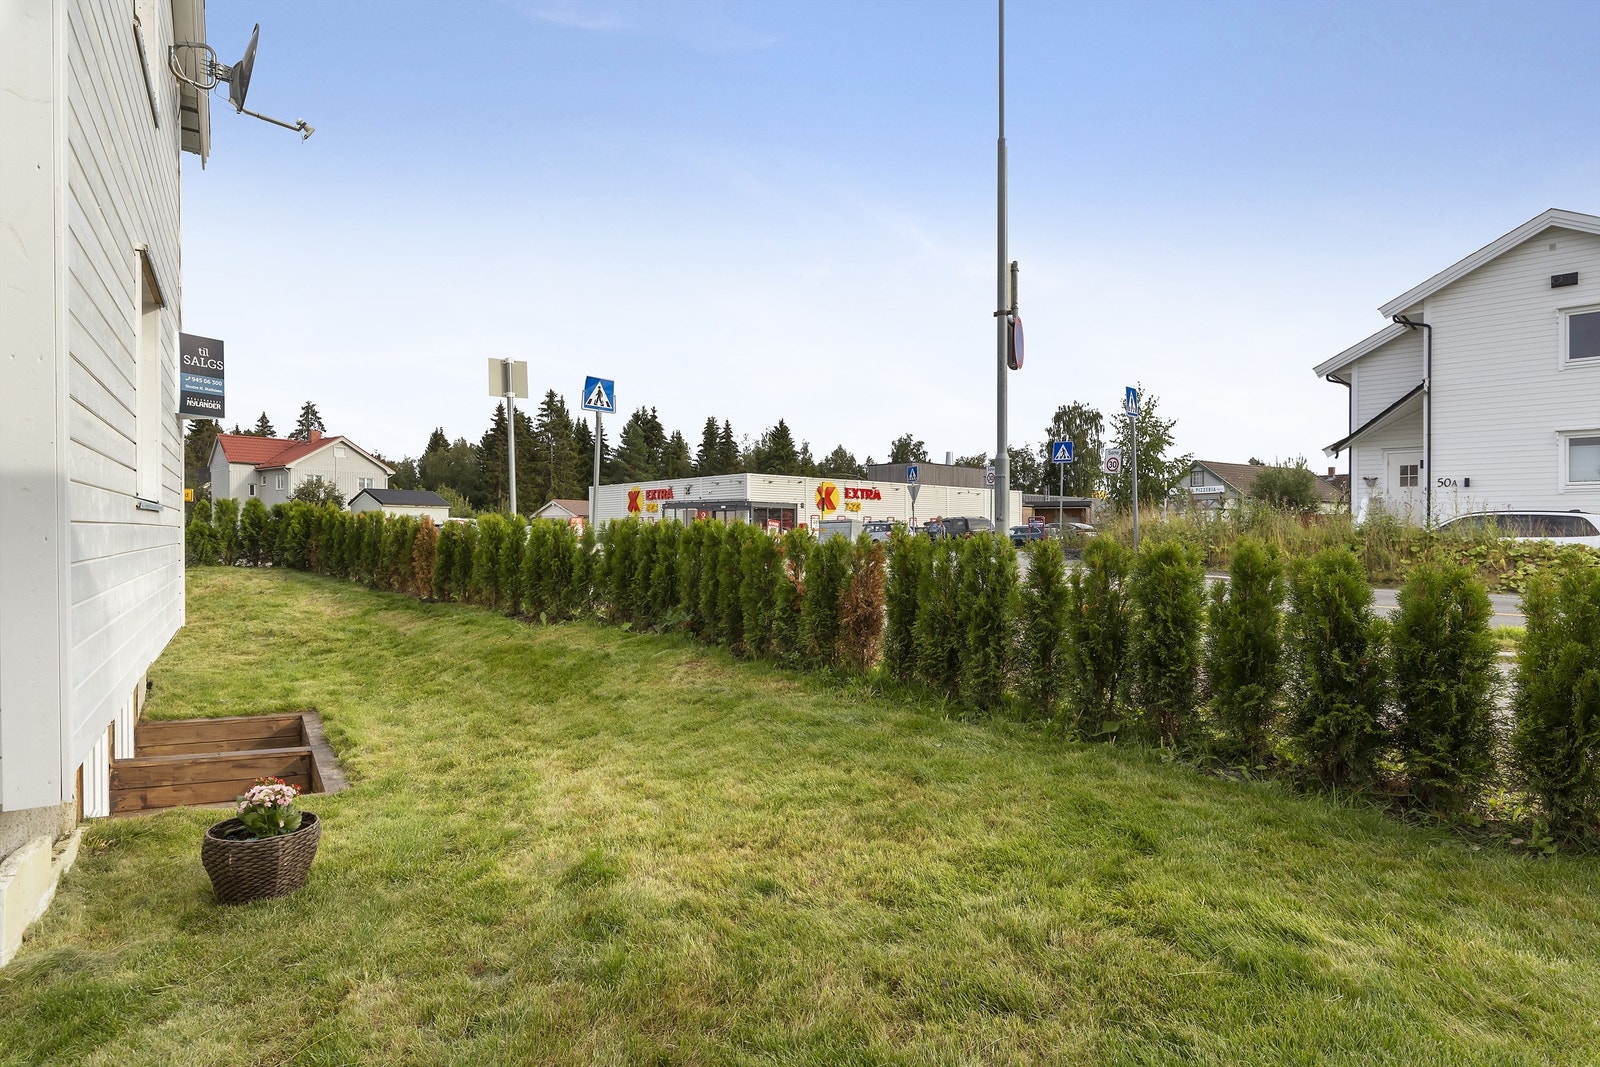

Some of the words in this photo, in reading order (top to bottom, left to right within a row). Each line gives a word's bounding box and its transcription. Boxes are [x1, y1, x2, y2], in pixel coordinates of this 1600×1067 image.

[198, 347, 209, 357] til
[183, 354, 224, 371] SALGS
[191, 376, 202, 384] 945
[186, 399, 222, 410] NYLANDER
[1109, 460, 1117, 468] 30
[1437, 477, 1458, 488] 50A
[645, 489, 674, 501] EXTRA
[845, 487, 882, 501] EXTRA
